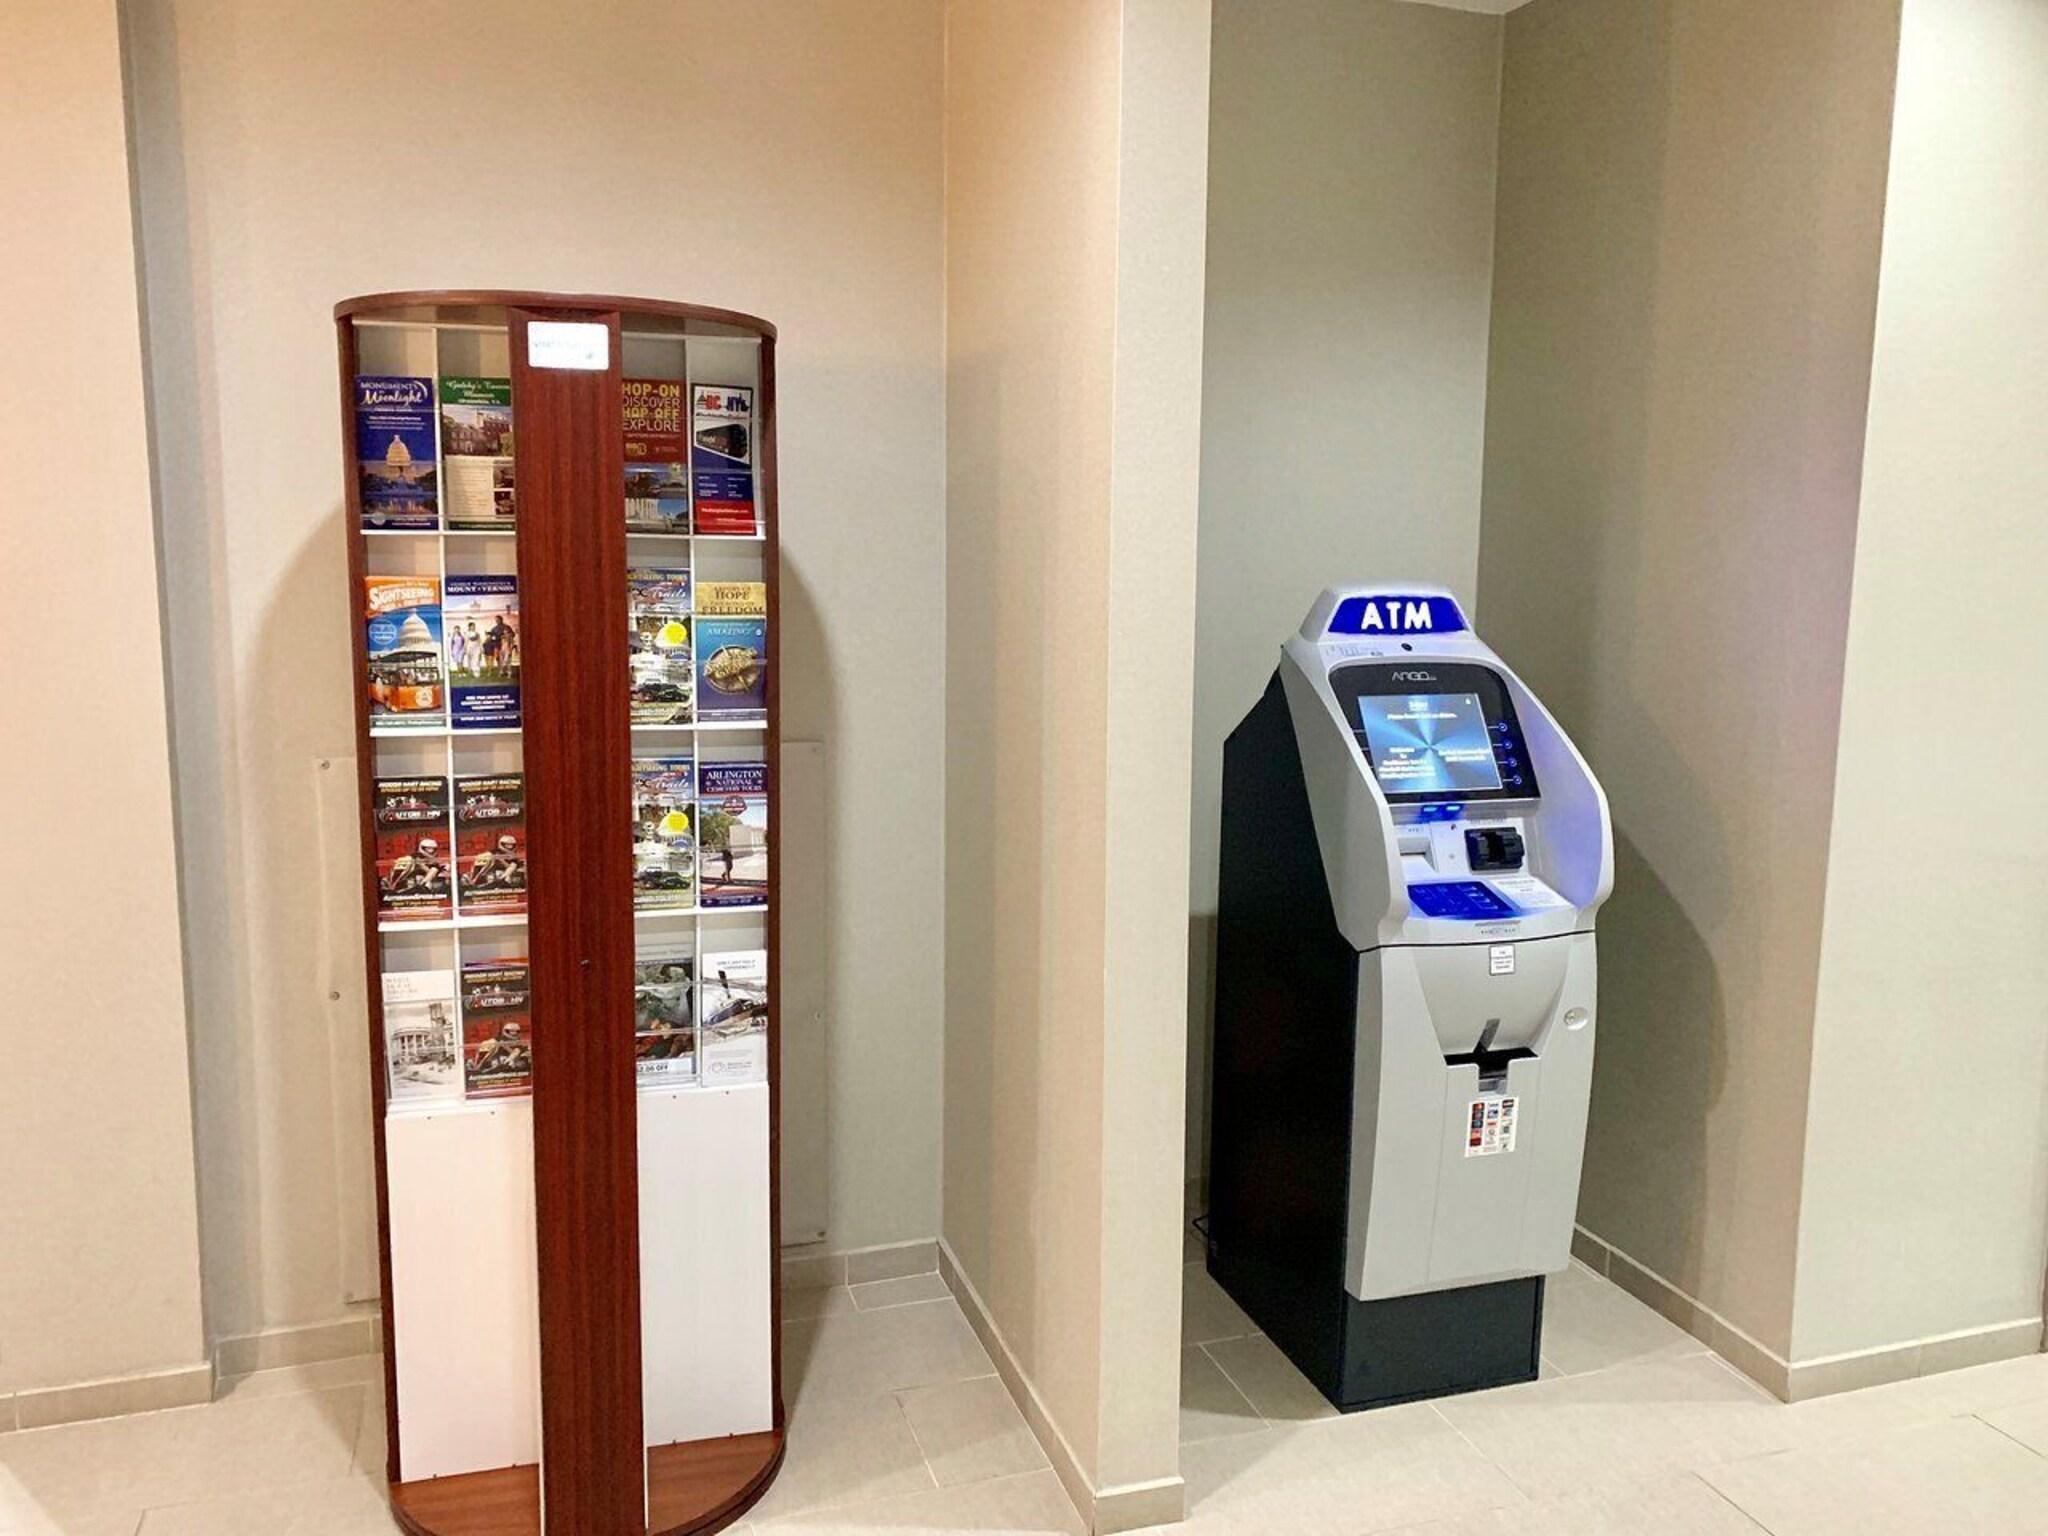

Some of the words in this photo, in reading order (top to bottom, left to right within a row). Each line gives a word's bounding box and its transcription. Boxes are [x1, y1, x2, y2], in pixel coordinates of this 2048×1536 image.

[622, 383, 680, 397] HOP-ON
[623, 396, 681, 409] DISCOVER
[622, 407, 681, 420] HOP-OFF
[623, 418, 681, 433] EXPLORE
[715, 591, 750, 600] HOPE
[702, 606, 765, 615] FREEDOM
[1360, 602, 1433, 630] ATM
[1391, 671, 1430, 682] ARGO
[706, 770, 763, 780] ARLINGTON
